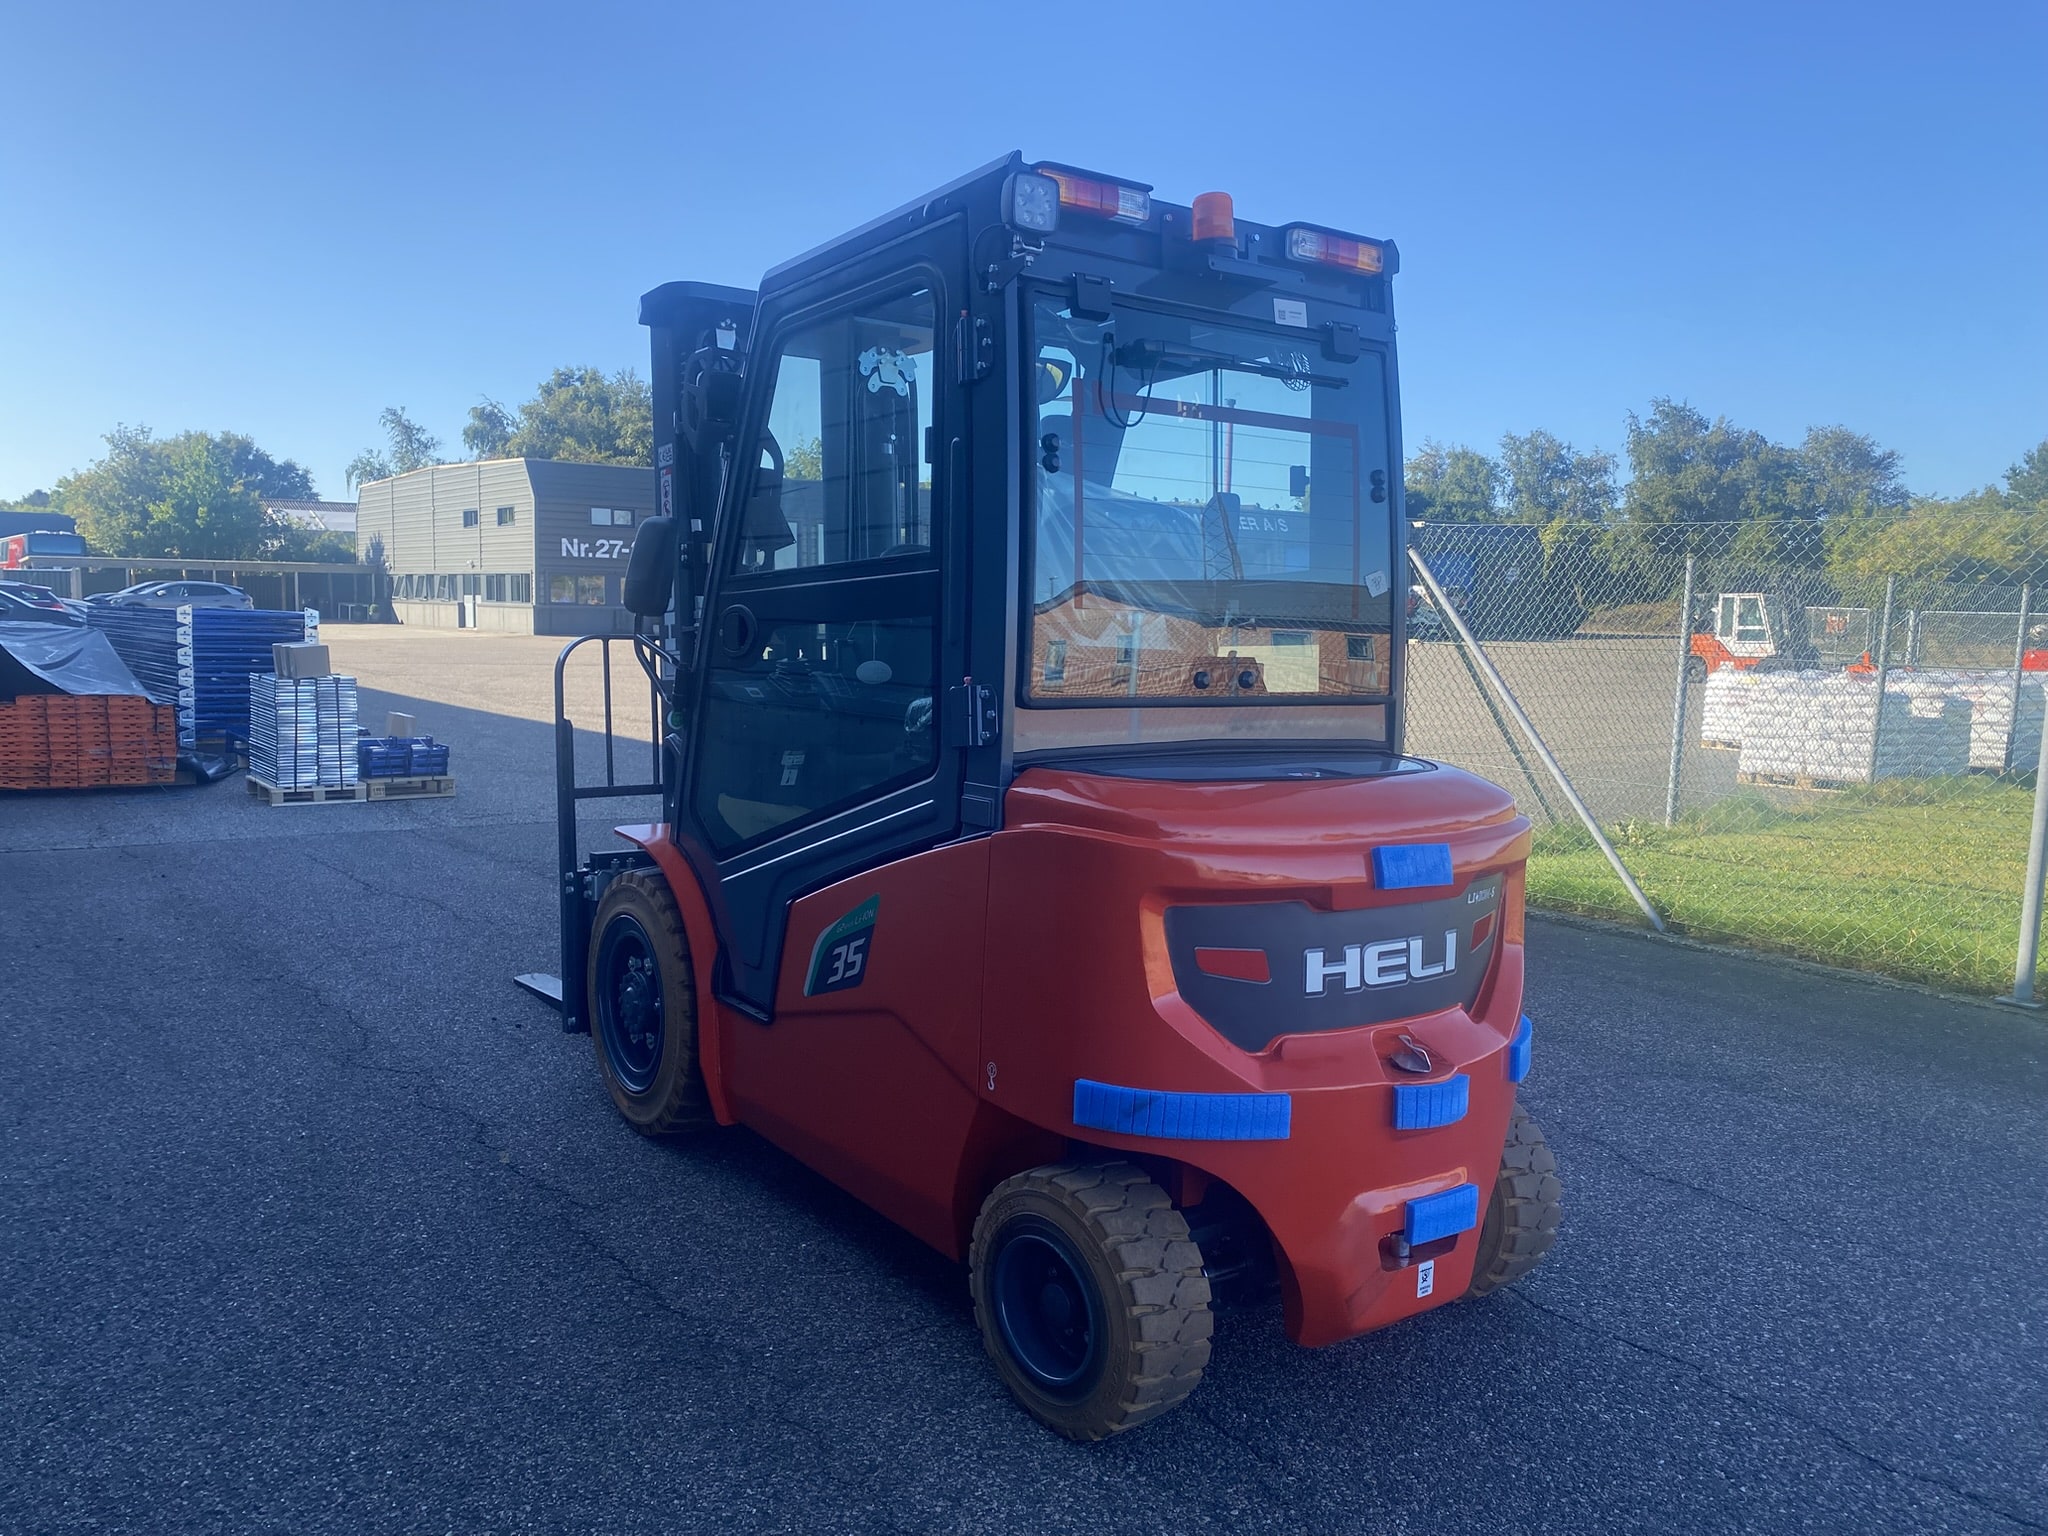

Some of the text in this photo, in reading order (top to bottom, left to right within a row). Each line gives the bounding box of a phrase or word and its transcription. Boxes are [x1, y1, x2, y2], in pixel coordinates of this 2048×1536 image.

[561, 537, 636, 559] Nr.27-
[827, 937, 866, 985] 35
[1304, 930, 1458, 996] HELI
